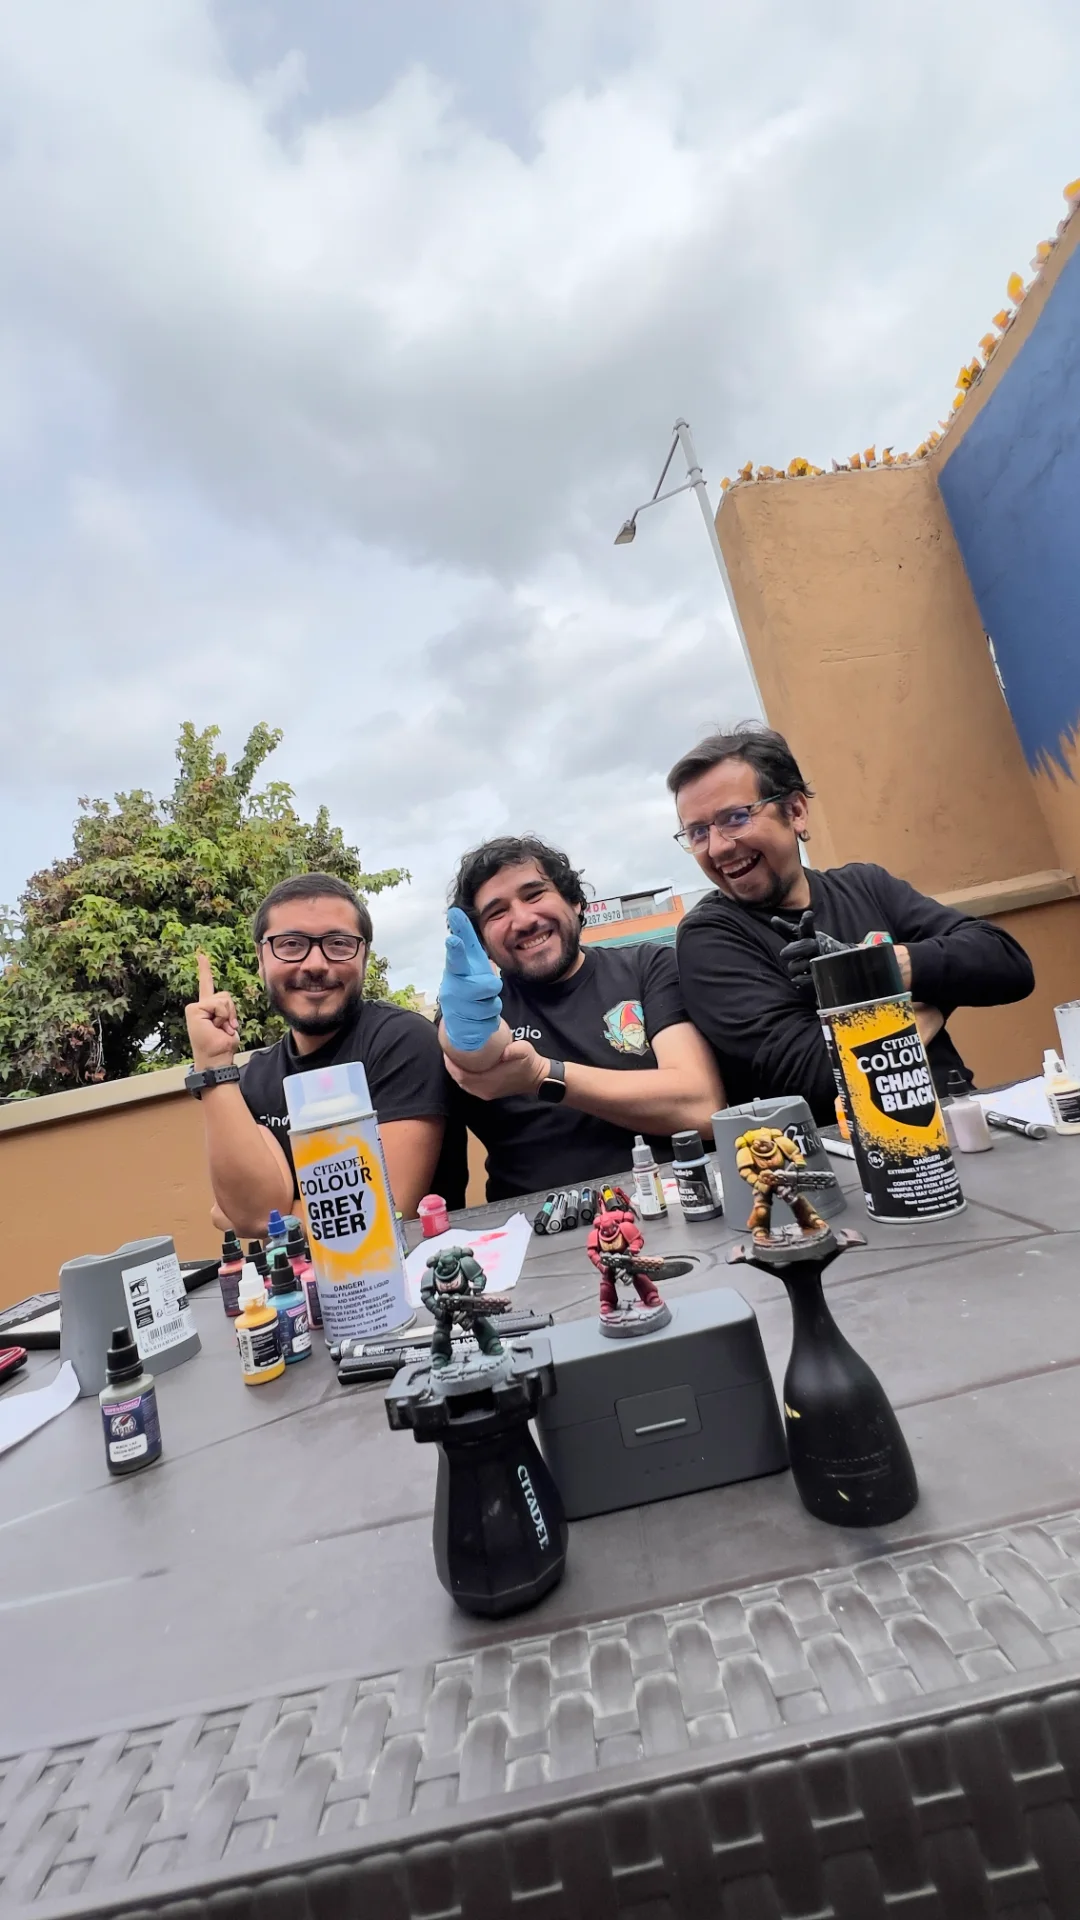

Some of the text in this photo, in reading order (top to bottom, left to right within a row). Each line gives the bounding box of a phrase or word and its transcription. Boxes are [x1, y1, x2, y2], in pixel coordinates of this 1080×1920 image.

[881, 1033, 920, 1051] CITADE
[856, 1045, 924, 1073] COLOU
[875, 1067, 930, 1094] CHAOS
[880, 1085, 936, 1113] BLACK
[313, 1155, 367, 1176] CITADEL
[913, 1154, 941, 1166] DANGER!
[300, 1167, 372, 1196] COLOUR
[308, 1191, 364, 1220] GREY
[311, 1213, 367, 1241] SEER
[333, 1280, 365, 1292] DANGER!
[342, 1285, 372, 1297] FLAMMABLE
[344, 1301, 362, 1309] UNDER
[347, 1314, 365, 1322] CAUSE
[517, 1465, 549, 1550] CITADEL
